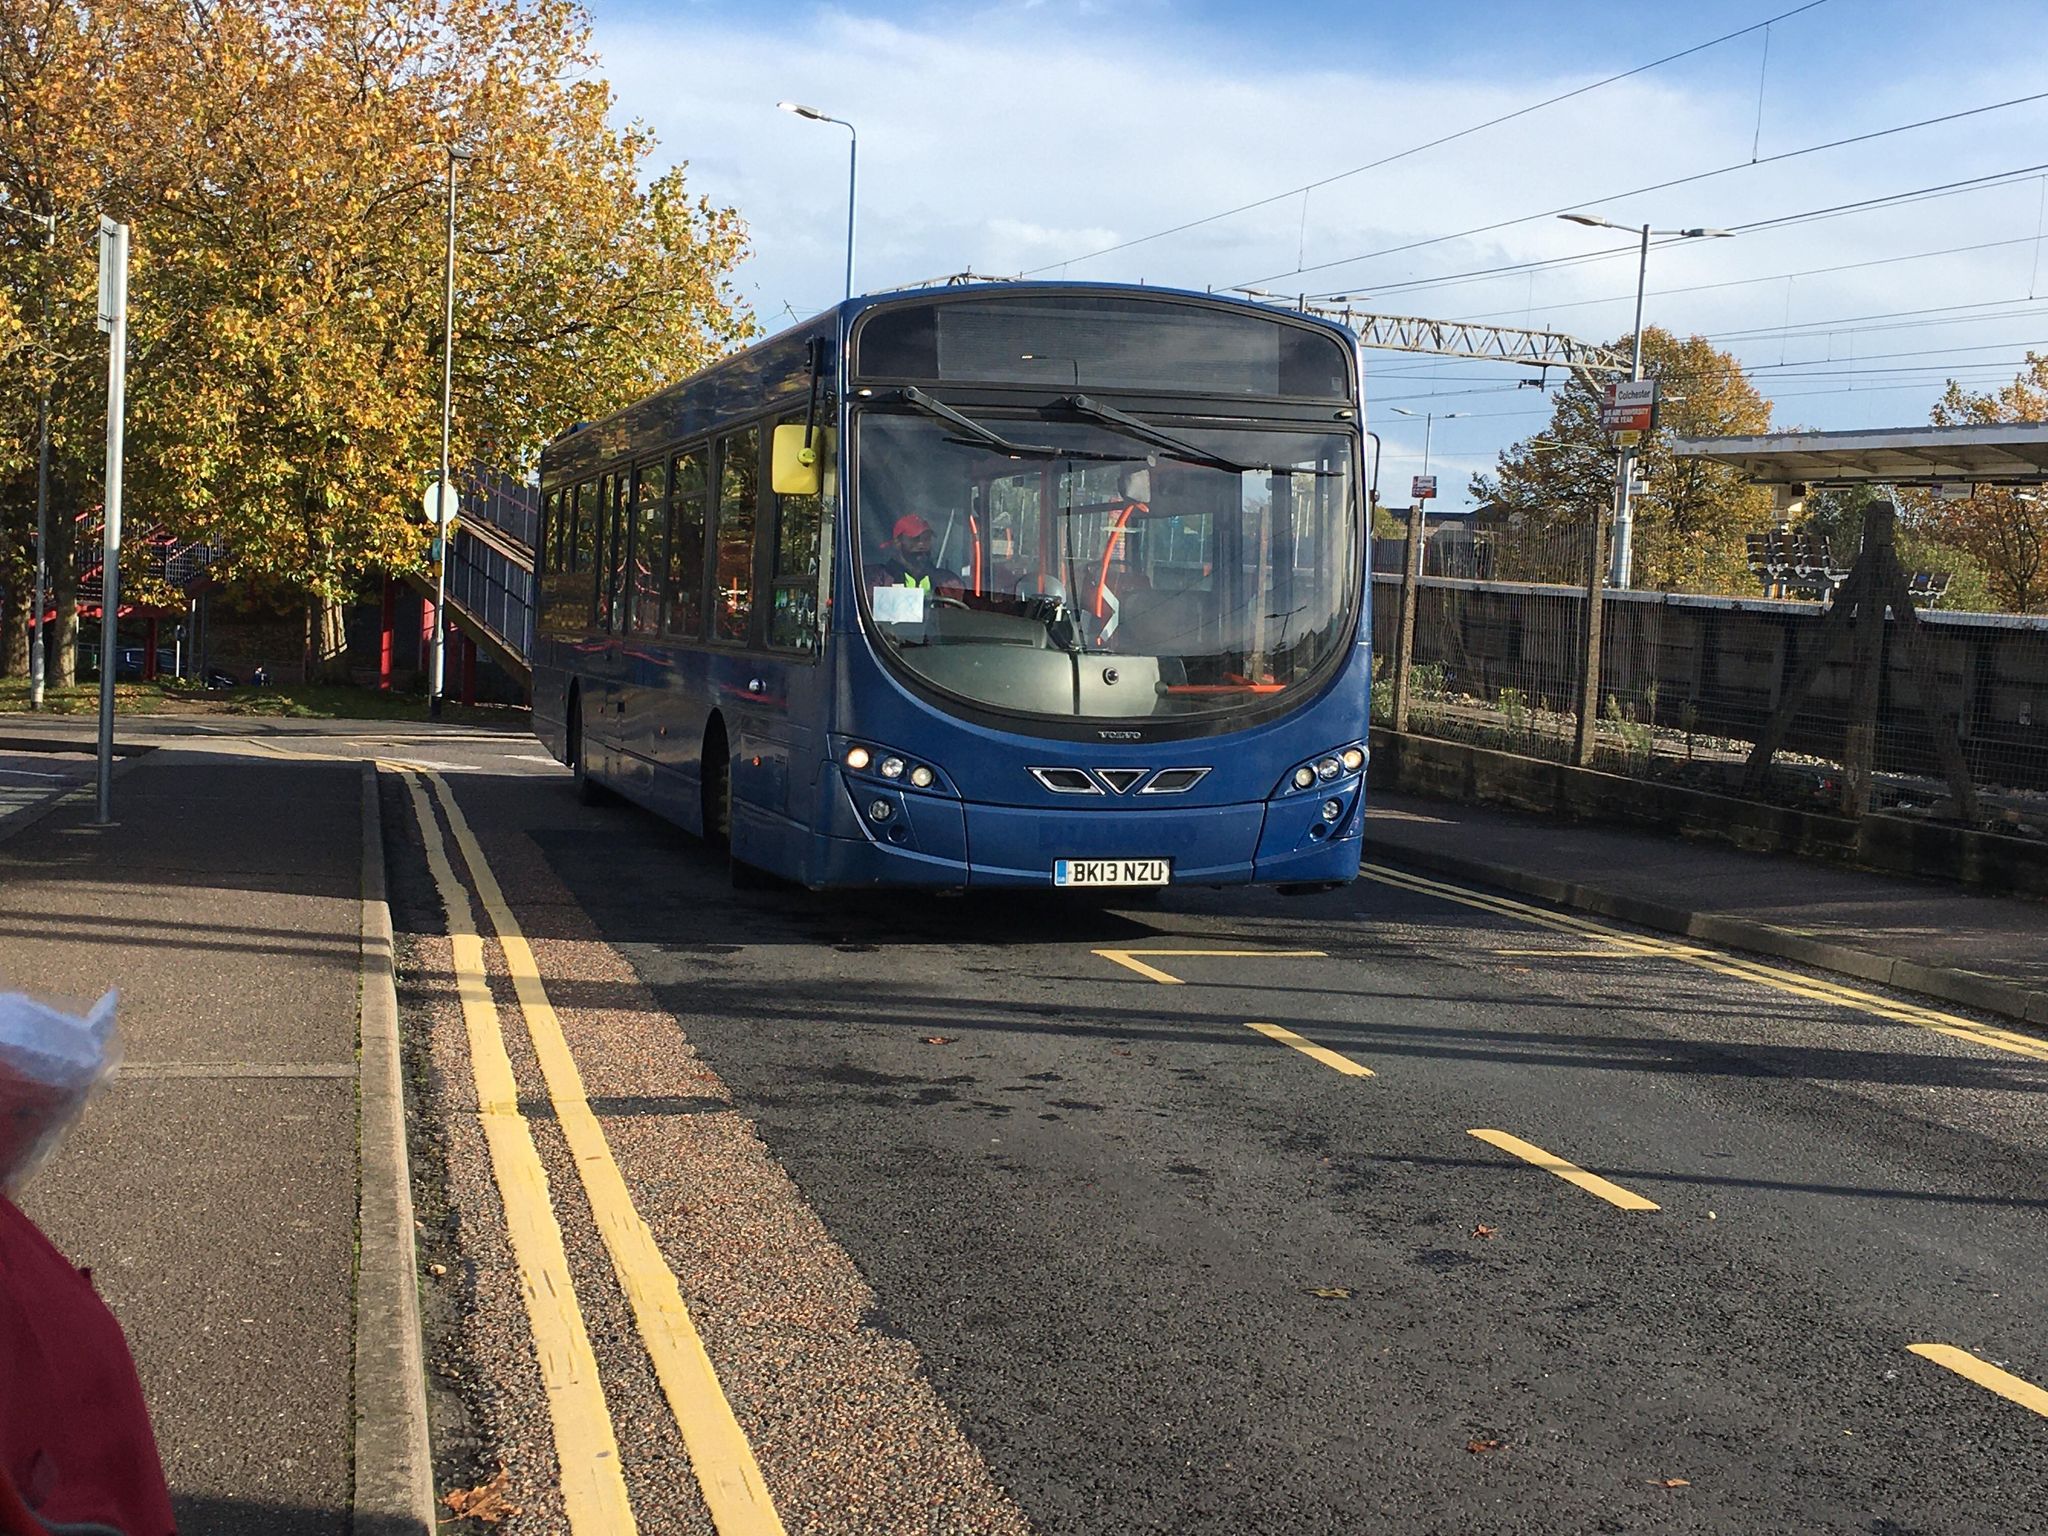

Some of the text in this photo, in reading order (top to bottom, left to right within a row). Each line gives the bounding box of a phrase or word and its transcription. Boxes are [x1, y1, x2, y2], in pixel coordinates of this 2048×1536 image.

[1618, 390, 1651, 400] Colchester
[1098, 731, 1141, 739] VOLVO
[1074, 862, 1162, 882] BK13 NZU
